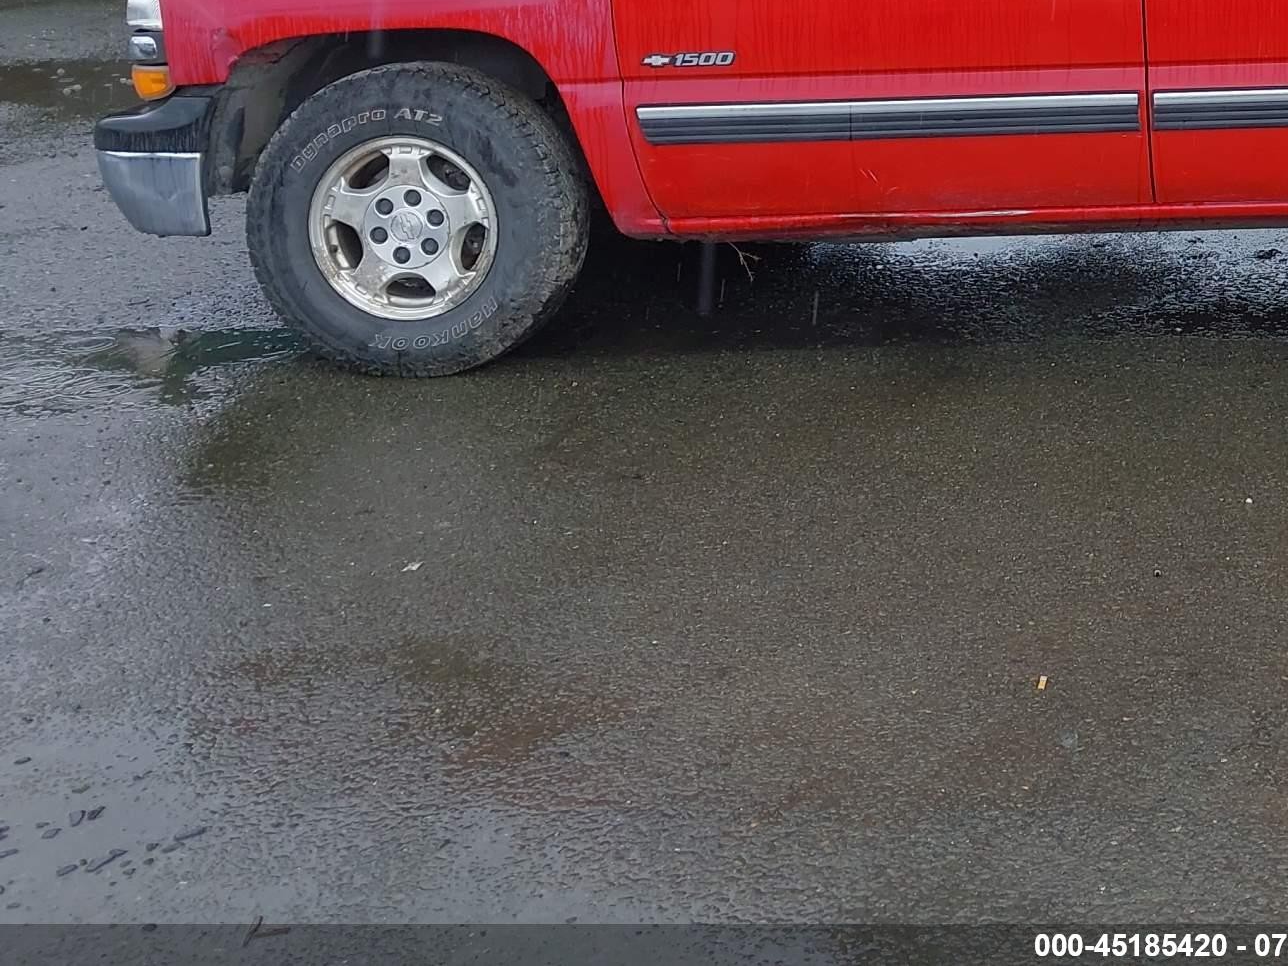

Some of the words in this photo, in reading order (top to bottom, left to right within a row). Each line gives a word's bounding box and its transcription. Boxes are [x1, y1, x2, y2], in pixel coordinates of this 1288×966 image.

[674, 52, 734, 66] 1500
[290, 109, 386, 172] Dynapro
[394, 108, 443, 127] AT2
